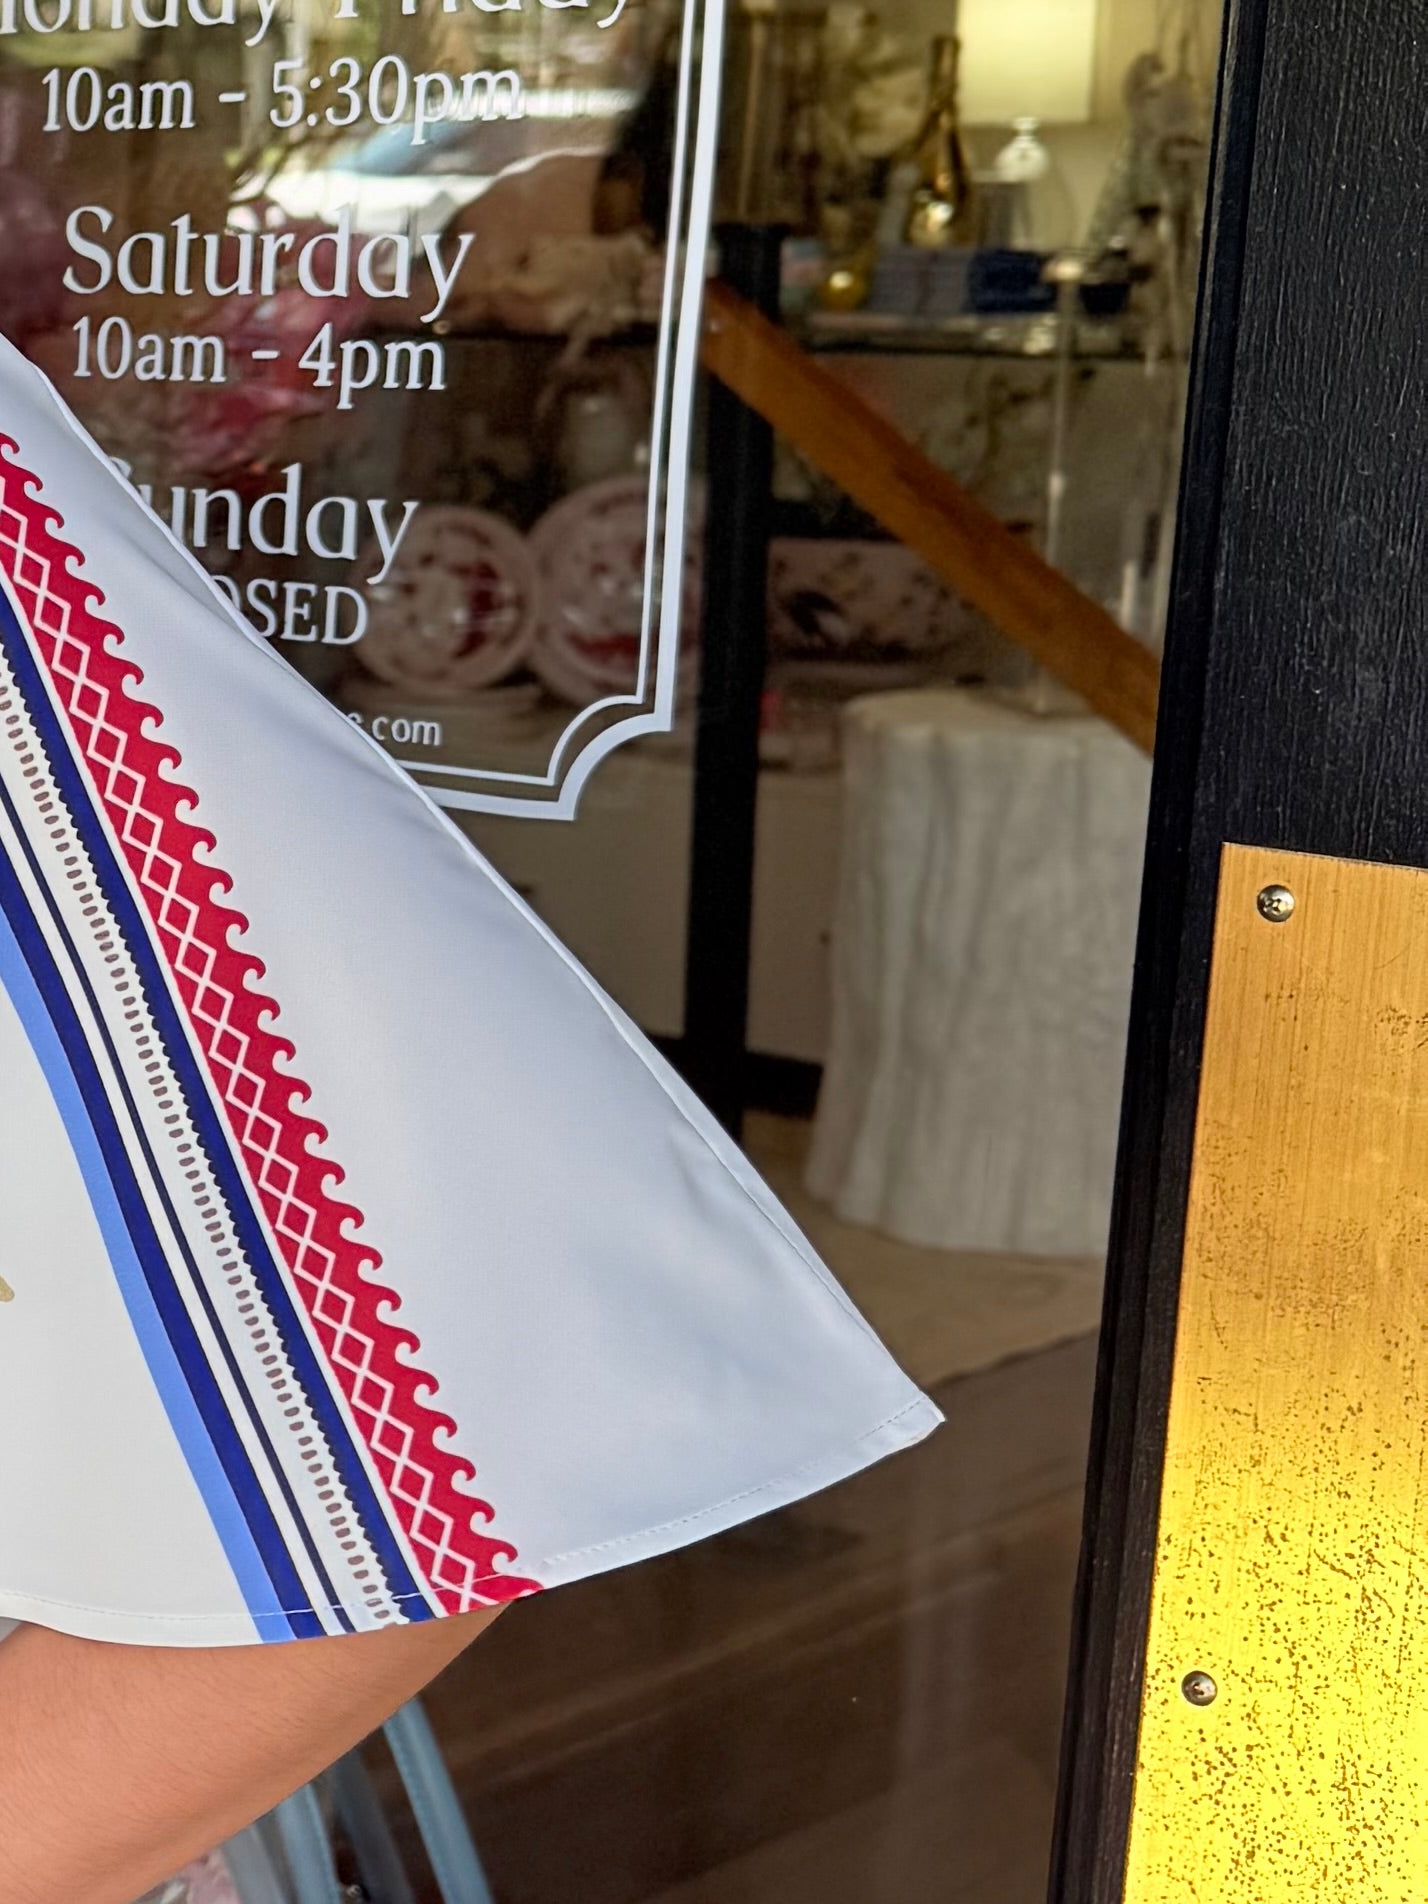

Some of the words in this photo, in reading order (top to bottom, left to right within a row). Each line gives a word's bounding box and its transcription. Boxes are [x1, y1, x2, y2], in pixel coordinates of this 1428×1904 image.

[42, 66, 195, 132] 10am
[218, 92, 246, 104] -
[269, 54, 523, 145] 5:30pm
[62, 204, 475, 323] Saturday
[72, 316, 226, 384] 10am
[250, 349, 279, 360] -
[298, 322, 446, 409] 4pm
[109, 456, 420, 585] unday
[211, 575, 368, 645] SED
